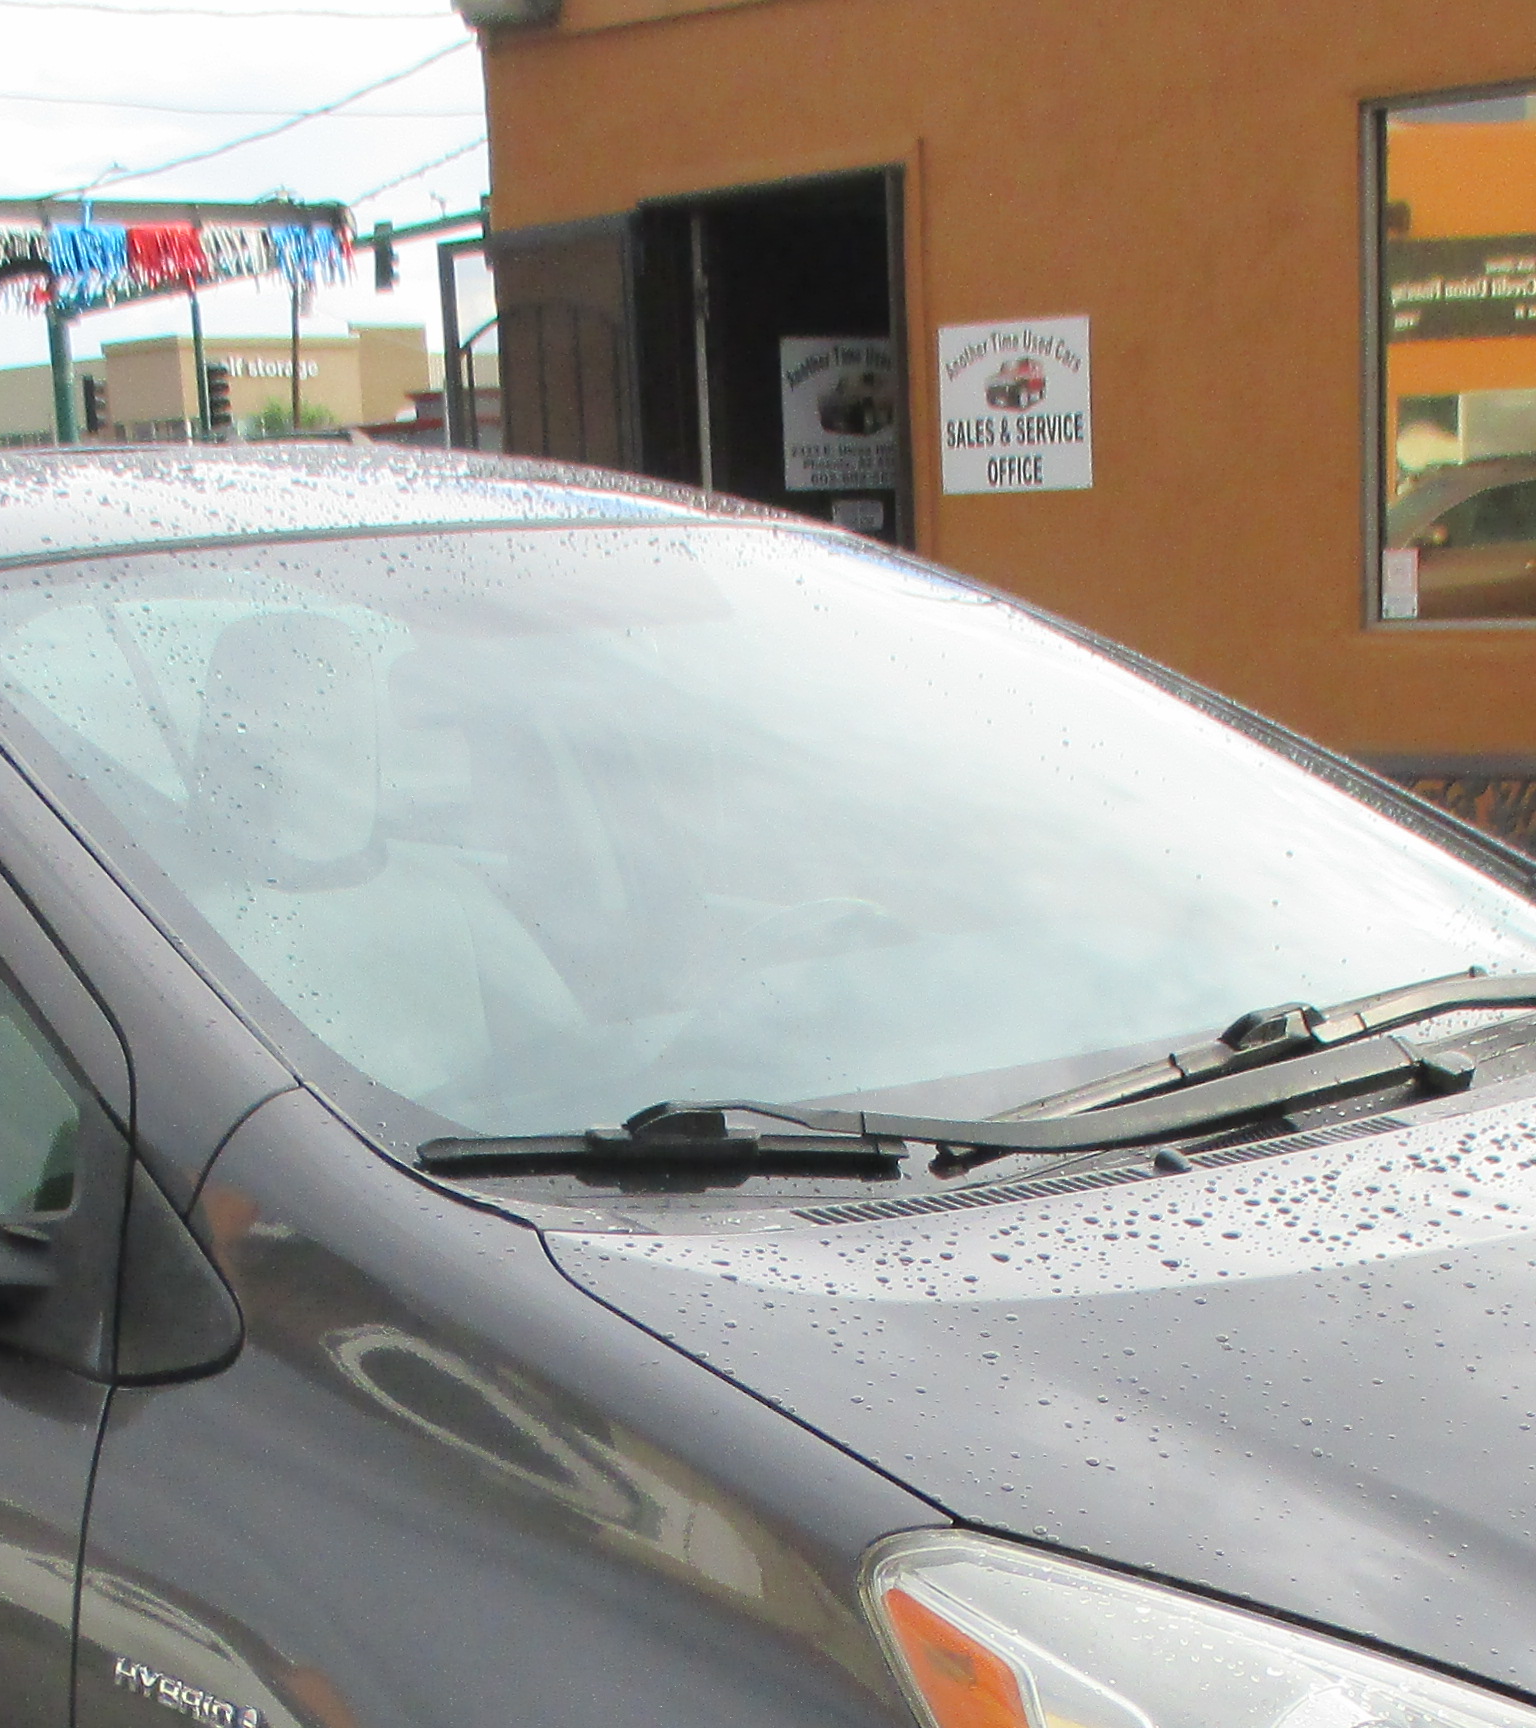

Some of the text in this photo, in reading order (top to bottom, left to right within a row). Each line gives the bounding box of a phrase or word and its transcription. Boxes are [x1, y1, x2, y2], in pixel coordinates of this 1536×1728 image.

[248, 356, 320, 381] storage
[945, 329, 1082, 382] Another Time Used Cars
[946, 411, 1084, 448] SALES & SERVICE
[987, 454, 1044, 487] OFFICE
